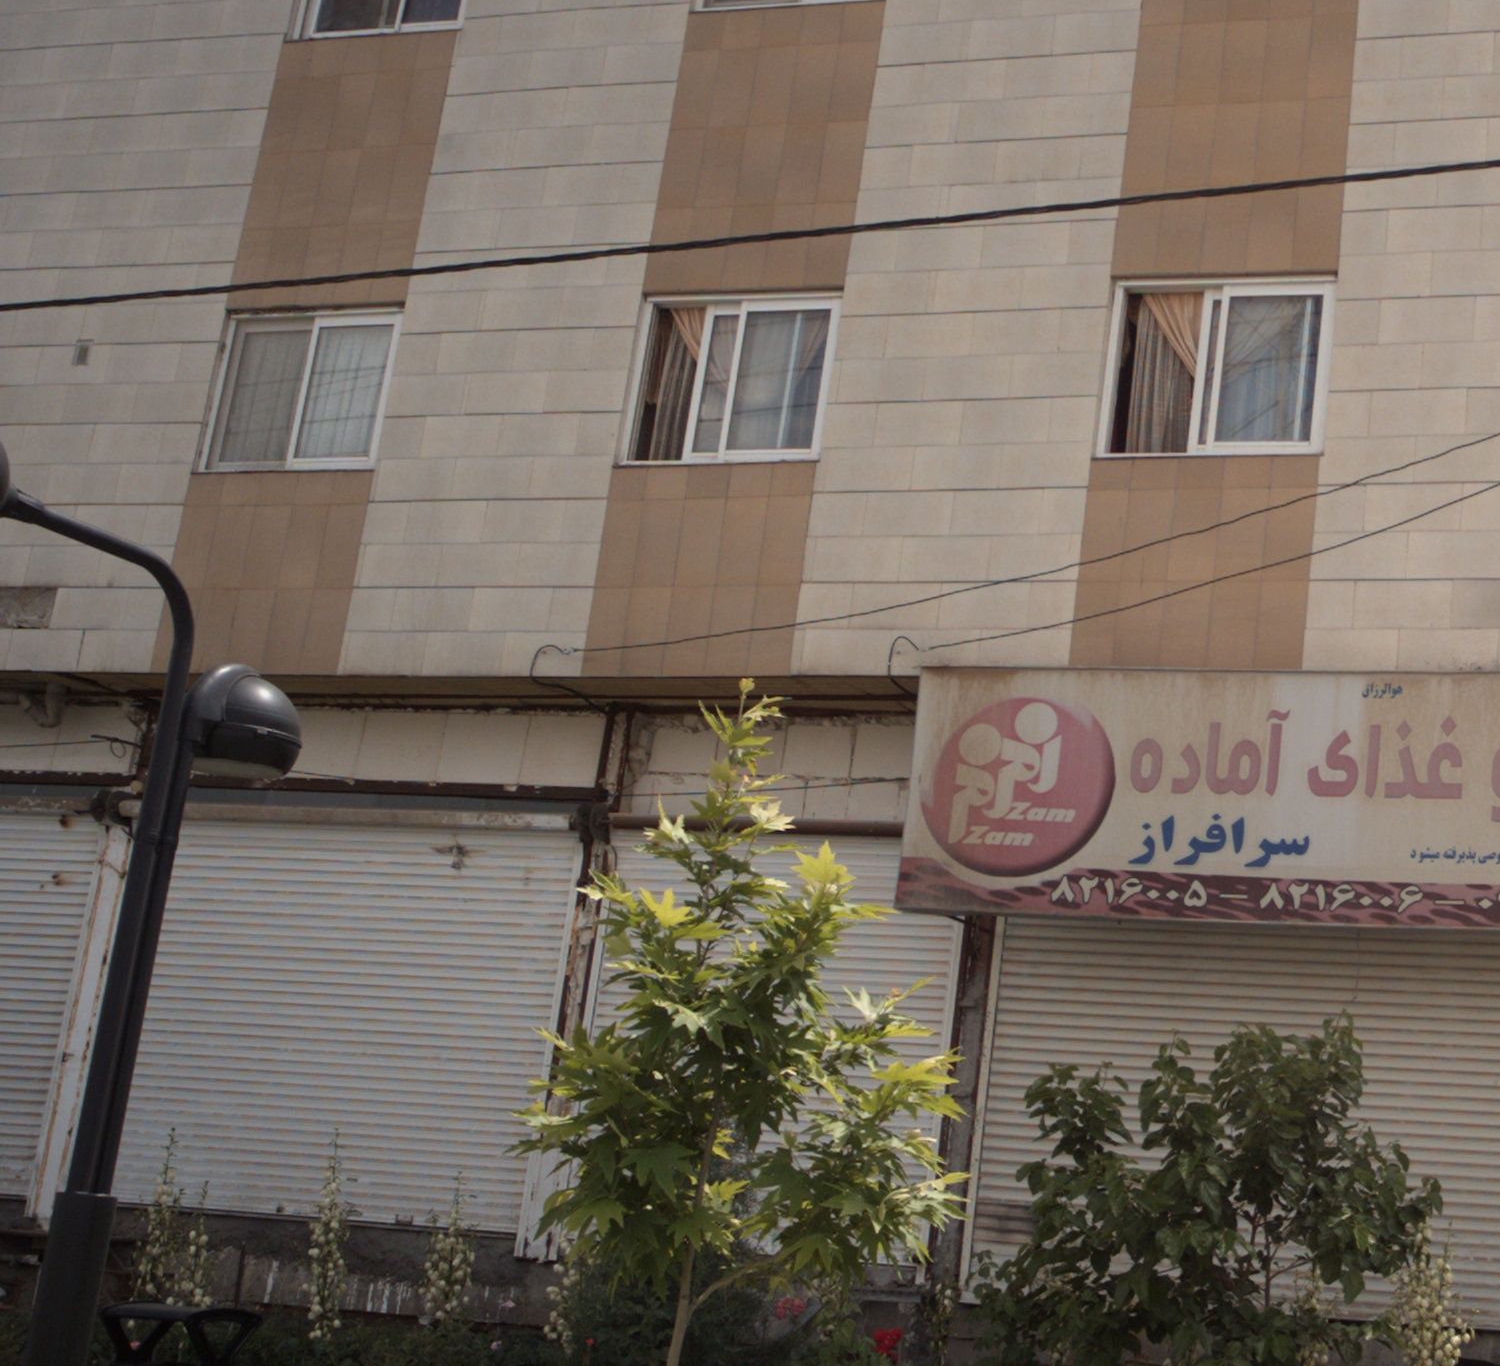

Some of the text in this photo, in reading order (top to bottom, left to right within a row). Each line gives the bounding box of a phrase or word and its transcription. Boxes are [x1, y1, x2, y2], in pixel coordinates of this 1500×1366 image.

[1130, 709, 1290, 797] آماده
[1307, 715, 1463, 800] غذای
[1004, 801, 1077, 823] Zam
[962, 825, 1035, 847] Zam
[1128, 812, 1312, 868] سرافراز
[1050, 874, 1209, 908] ۸۲۱۶۰۰۵
[1258, 881, 1425, 914] ۸۲۱۶۰۰۶
